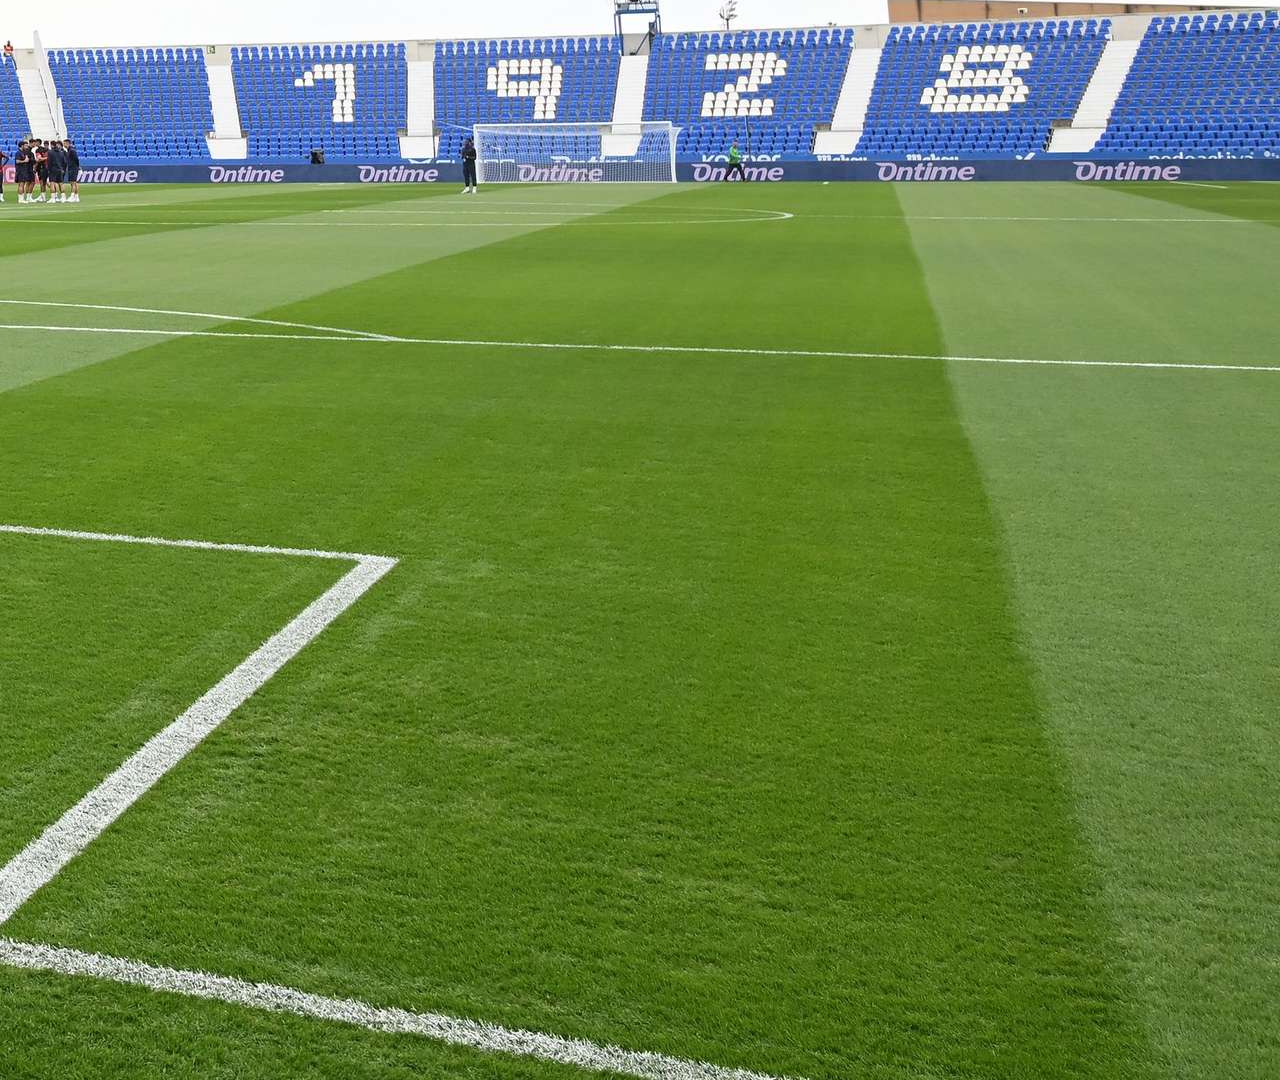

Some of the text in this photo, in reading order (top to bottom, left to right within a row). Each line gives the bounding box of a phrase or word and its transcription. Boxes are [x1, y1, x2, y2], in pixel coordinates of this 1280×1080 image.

[208, 165, 284, 183] Ontime
[357, 165, 439, 183] Ontime
[517, 164, 603, 182] Ontime
[875, 162, 976, 181] Ontime
[1072, 160, 1181, 181] Ontime
